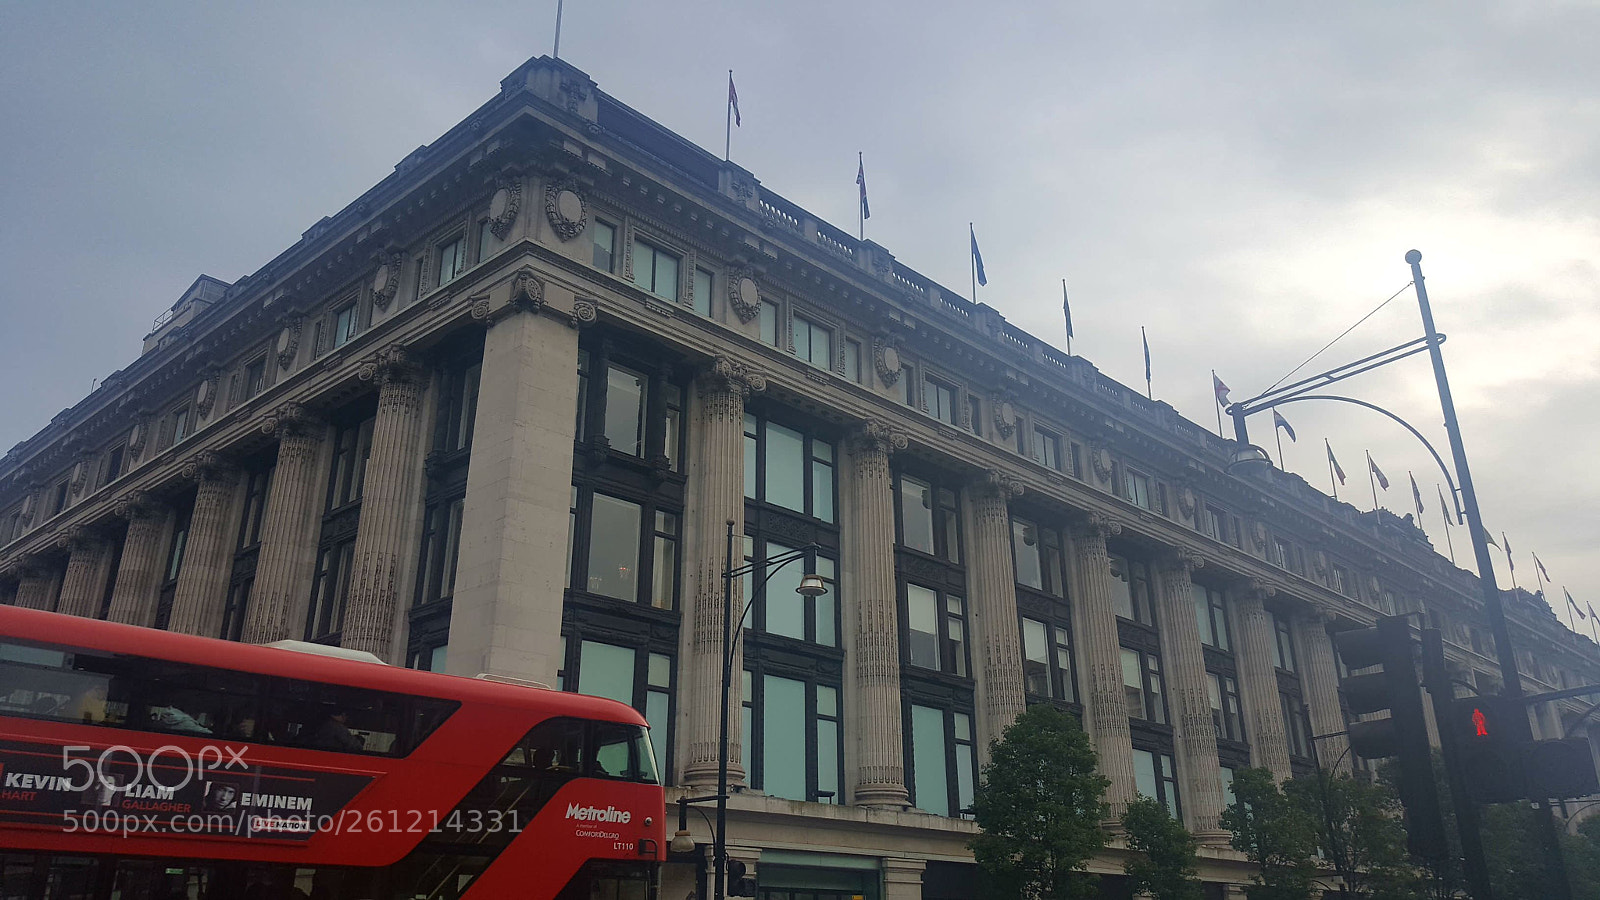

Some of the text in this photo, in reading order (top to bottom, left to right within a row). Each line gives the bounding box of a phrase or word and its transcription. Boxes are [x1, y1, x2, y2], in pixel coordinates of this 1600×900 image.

[5, 772, 72, 791] KEVIN
[1, 790, 36, 802] HART
[124, 783, 175, 801] LIAM
[122, 799, 192, 814] GALLAGHER
[240, 792, 313, 811] EMINEM
[565, 802, 631, 823] Metroline
[613, 842, 633, 850] LT110
